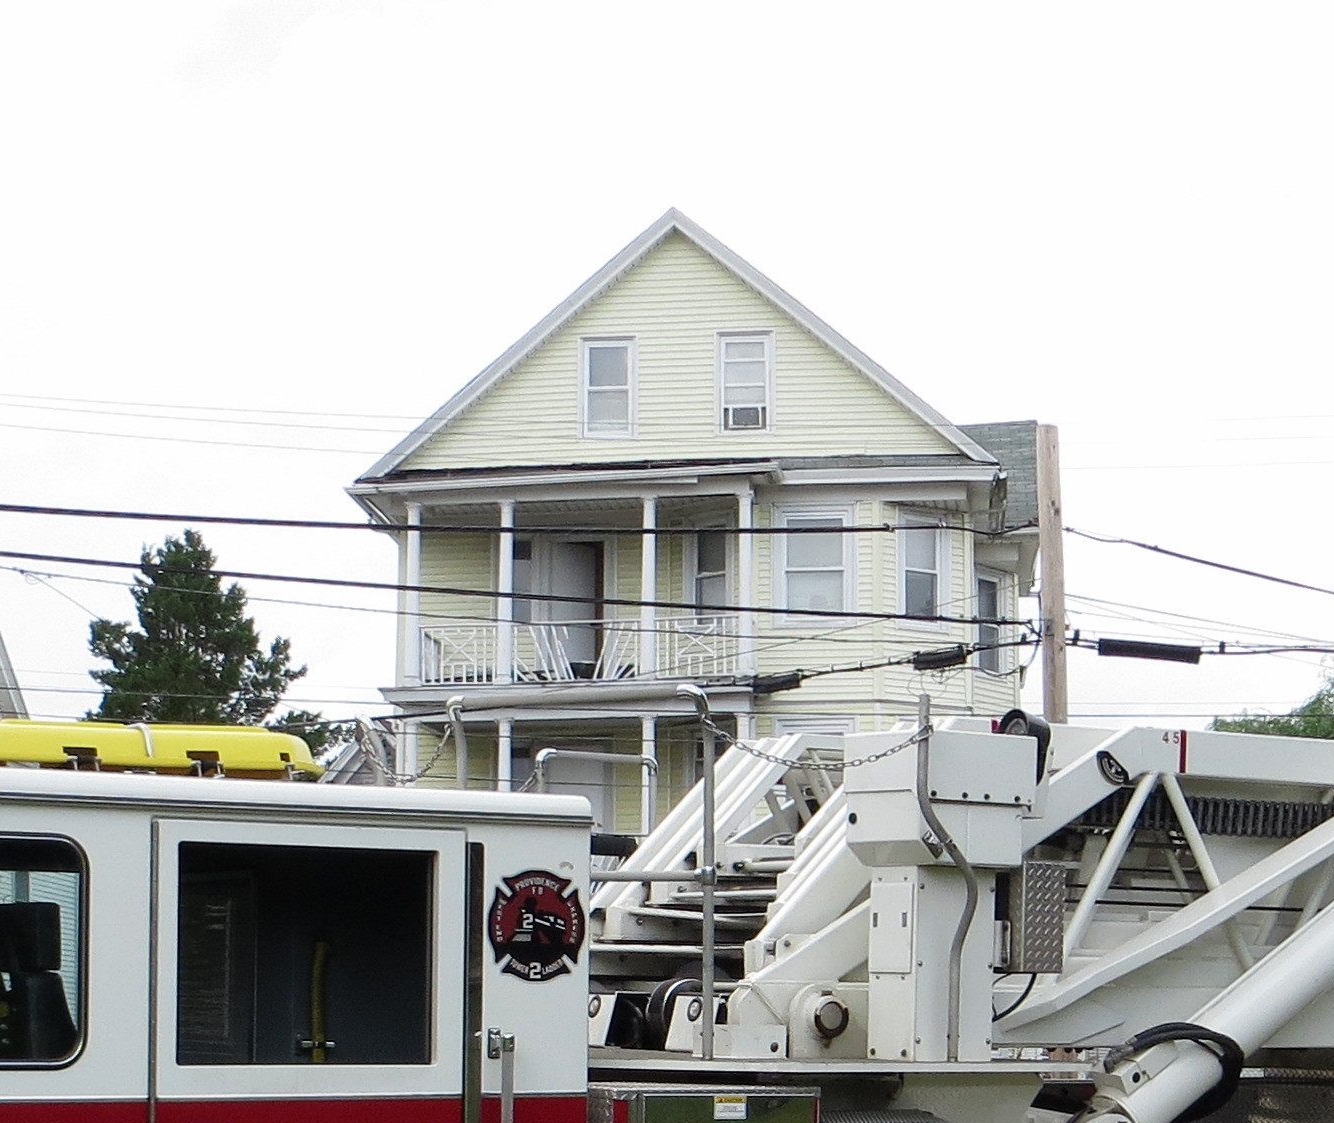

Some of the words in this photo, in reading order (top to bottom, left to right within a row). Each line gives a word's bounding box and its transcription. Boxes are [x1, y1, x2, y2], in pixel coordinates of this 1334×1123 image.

[1161, 731, 1180, 744] 45
[522, 913, 534, 929] 2
[529, 961, 542, 979] 2
